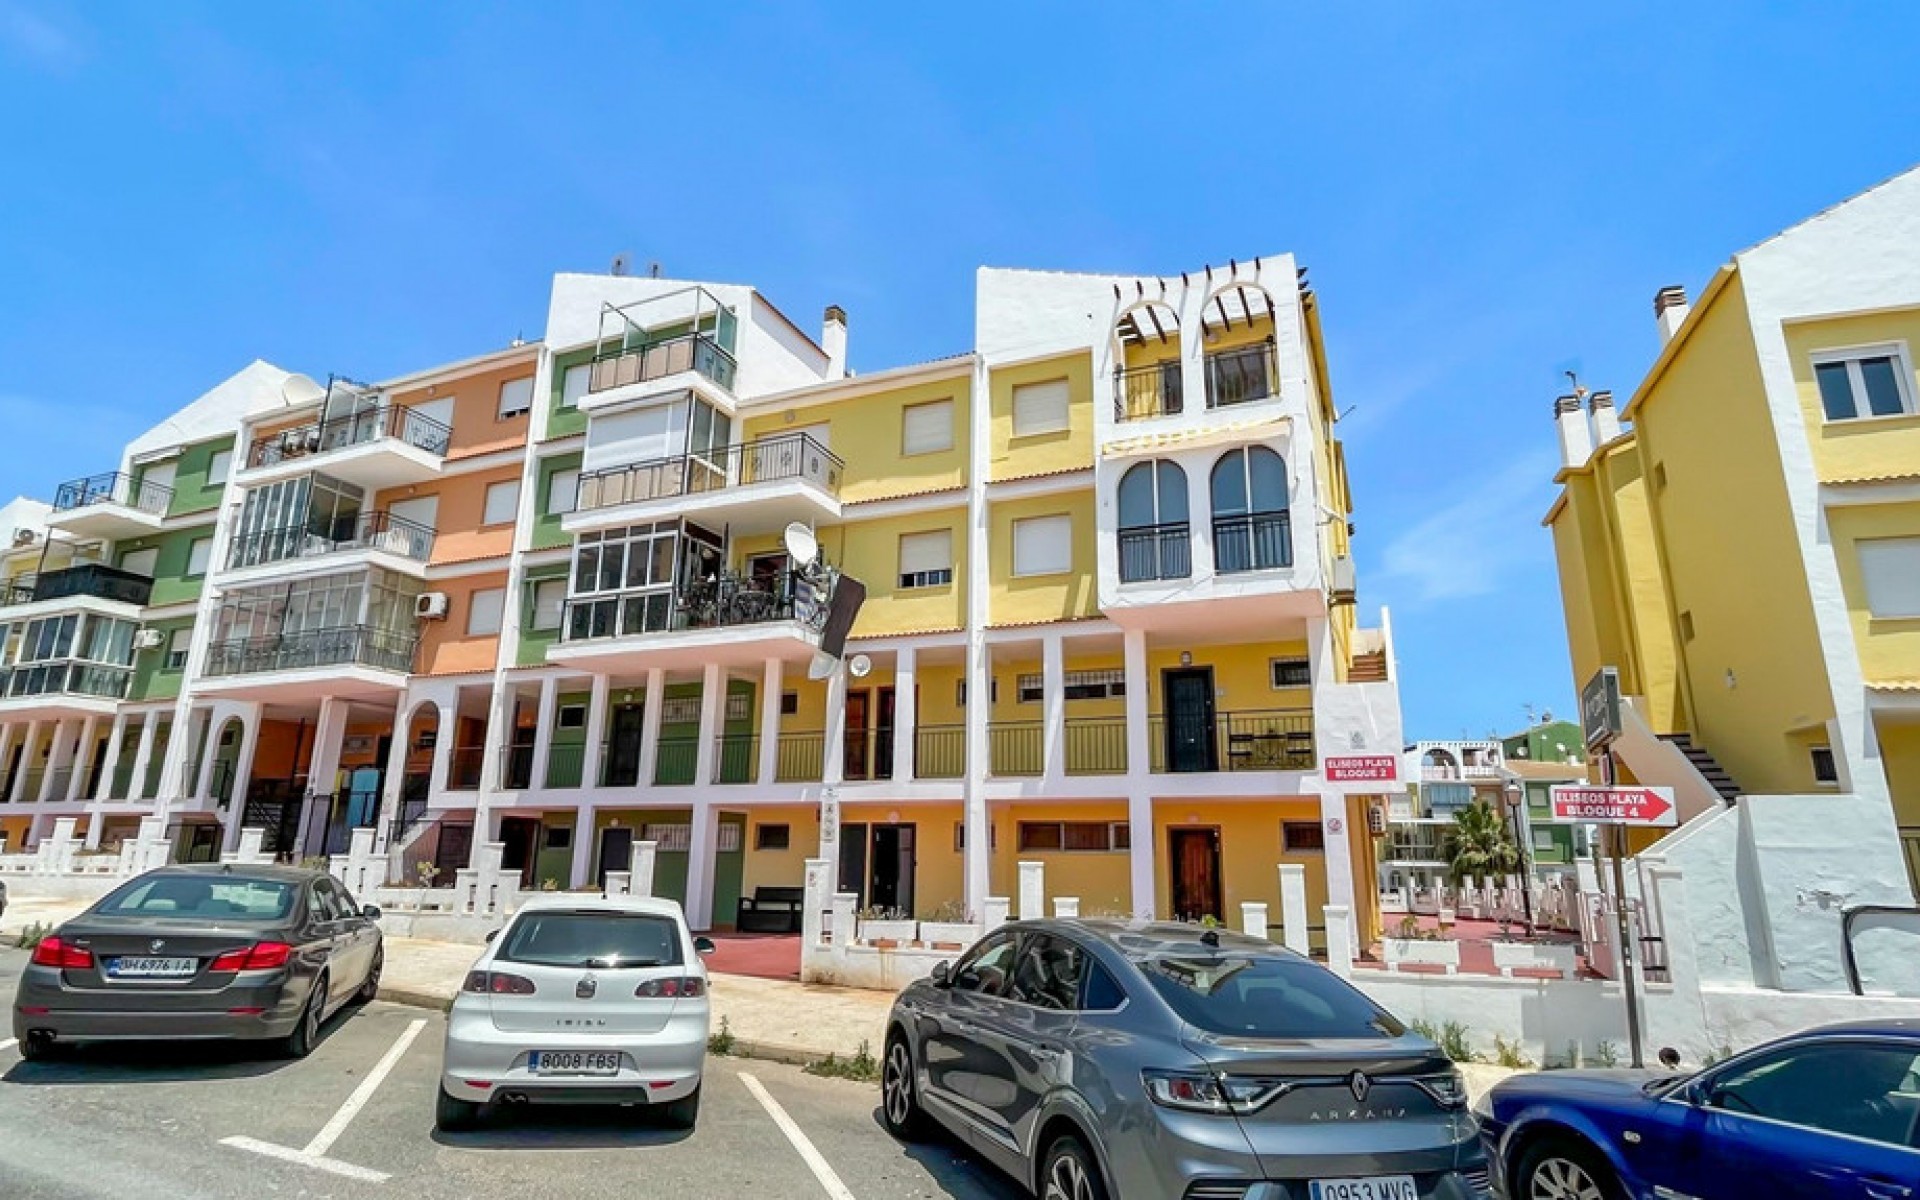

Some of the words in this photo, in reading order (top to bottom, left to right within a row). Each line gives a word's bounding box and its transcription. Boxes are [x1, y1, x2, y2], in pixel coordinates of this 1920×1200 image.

[1327, 758, 1363, 768] ELISEOS
[1364, 758, 1393, 767] PLAYA
[1335, 769, 1376, 778] BLOQUE
[1380, 768, 1387, 777] 2
[1556, 792, 1605, 804] ELISEOS
[1608, 794, 1648, 805] PLAYA
[1566, 805, 1626, 817] BLOQUE
[1629, 805, 1639, 817] 4
[541, 1053, 581, 1069] 8008
[585, 1053, 617, 1069] FBS
[1325, 1182, 1374, 1200] 0953
